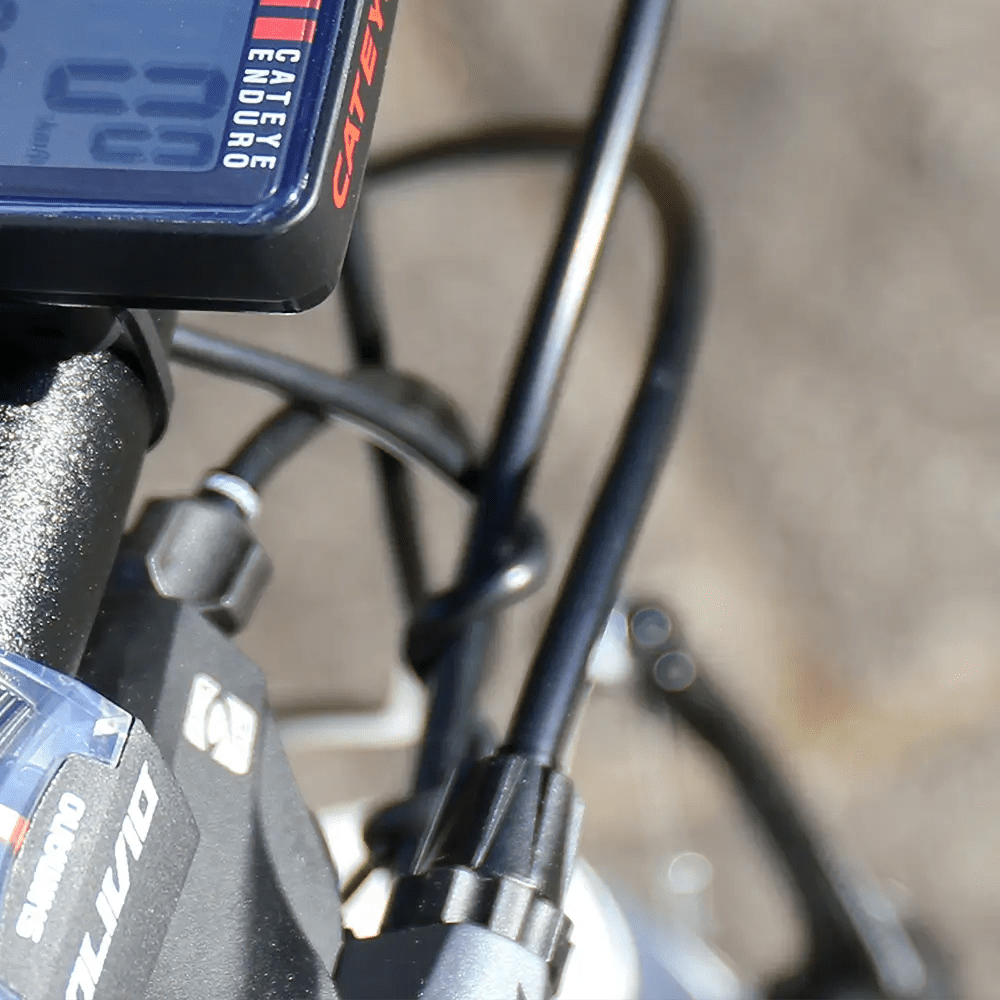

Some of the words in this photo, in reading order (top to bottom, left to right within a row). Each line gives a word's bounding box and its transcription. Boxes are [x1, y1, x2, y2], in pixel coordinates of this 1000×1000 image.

[223, 48, 274, 169] ENDURO
[250, 48, 301, 170] CATEYE
[15, 792, 86, 944] SHIMANO
